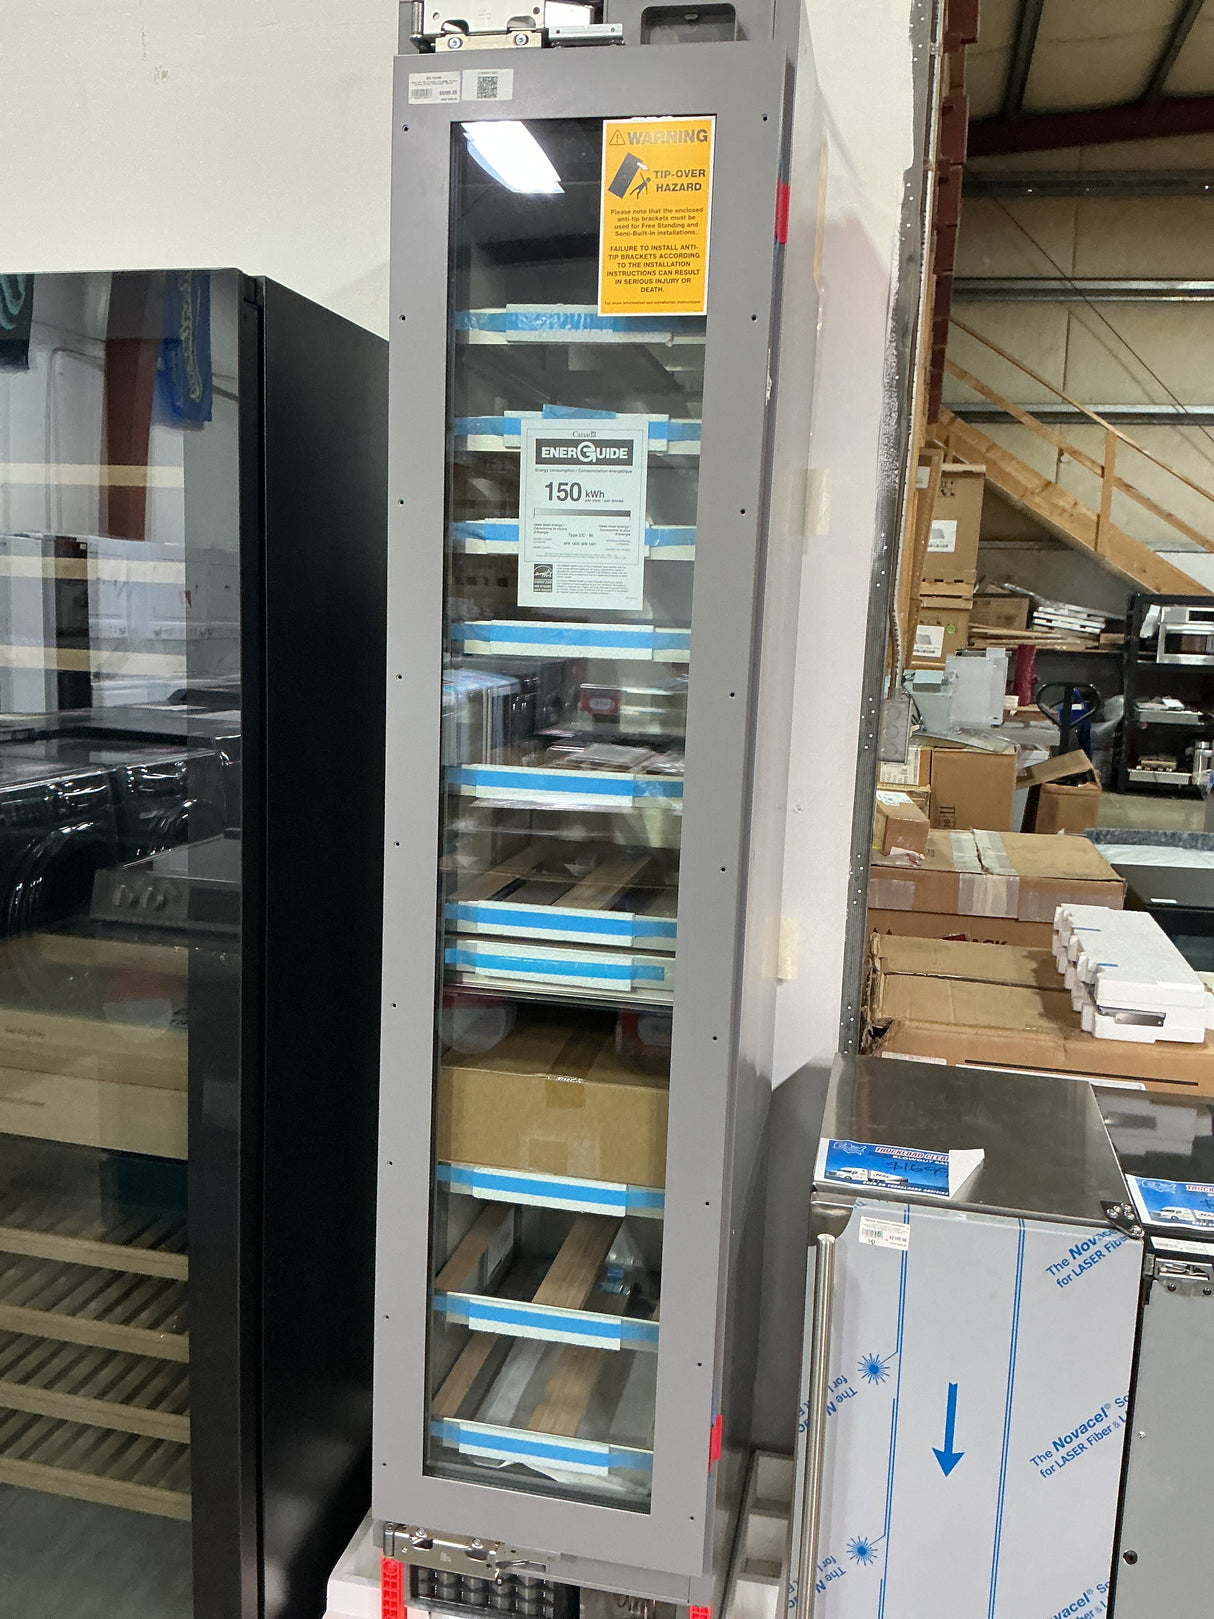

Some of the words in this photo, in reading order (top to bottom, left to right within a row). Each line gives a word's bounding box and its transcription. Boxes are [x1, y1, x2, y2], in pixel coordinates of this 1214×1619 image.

[628, 129, 708, 146] WARNING
[654, 169, 706, 179] TIP-OVER
[656, 182, 702, 192] HAZARD
[541, 442, 629, 463] ENERGUIDE
[544, 481, 582, 502] 150
[585, 490, 605, 498] kWh
[875, 1146, 924, 1159] TRUCKLOAD
[893, 1156, 933, 1164] BLOWOUT
[1045, 1258, 1070, 1276] The
[1068, 1228, 1118, 1260] Novace
[1056, 1273, 1073, 1288] for
[1072, 1250, 1106, 1277] LASER
[1104, 1235, 1129, 1254] Fibe
[831, 1374, 848, 1389] for
[835, 1386, 858, 1403] The
[1029, 1449, 1054, 1467] The
[1039, 1463, 1056, 1478] for
[1054, 1442, 1088, 1468] LASER
[1086, 1425, 1113, 1446] Fiber
[822, 1555, 837, 1568] for
[824, 1566, 847, 1582] The
